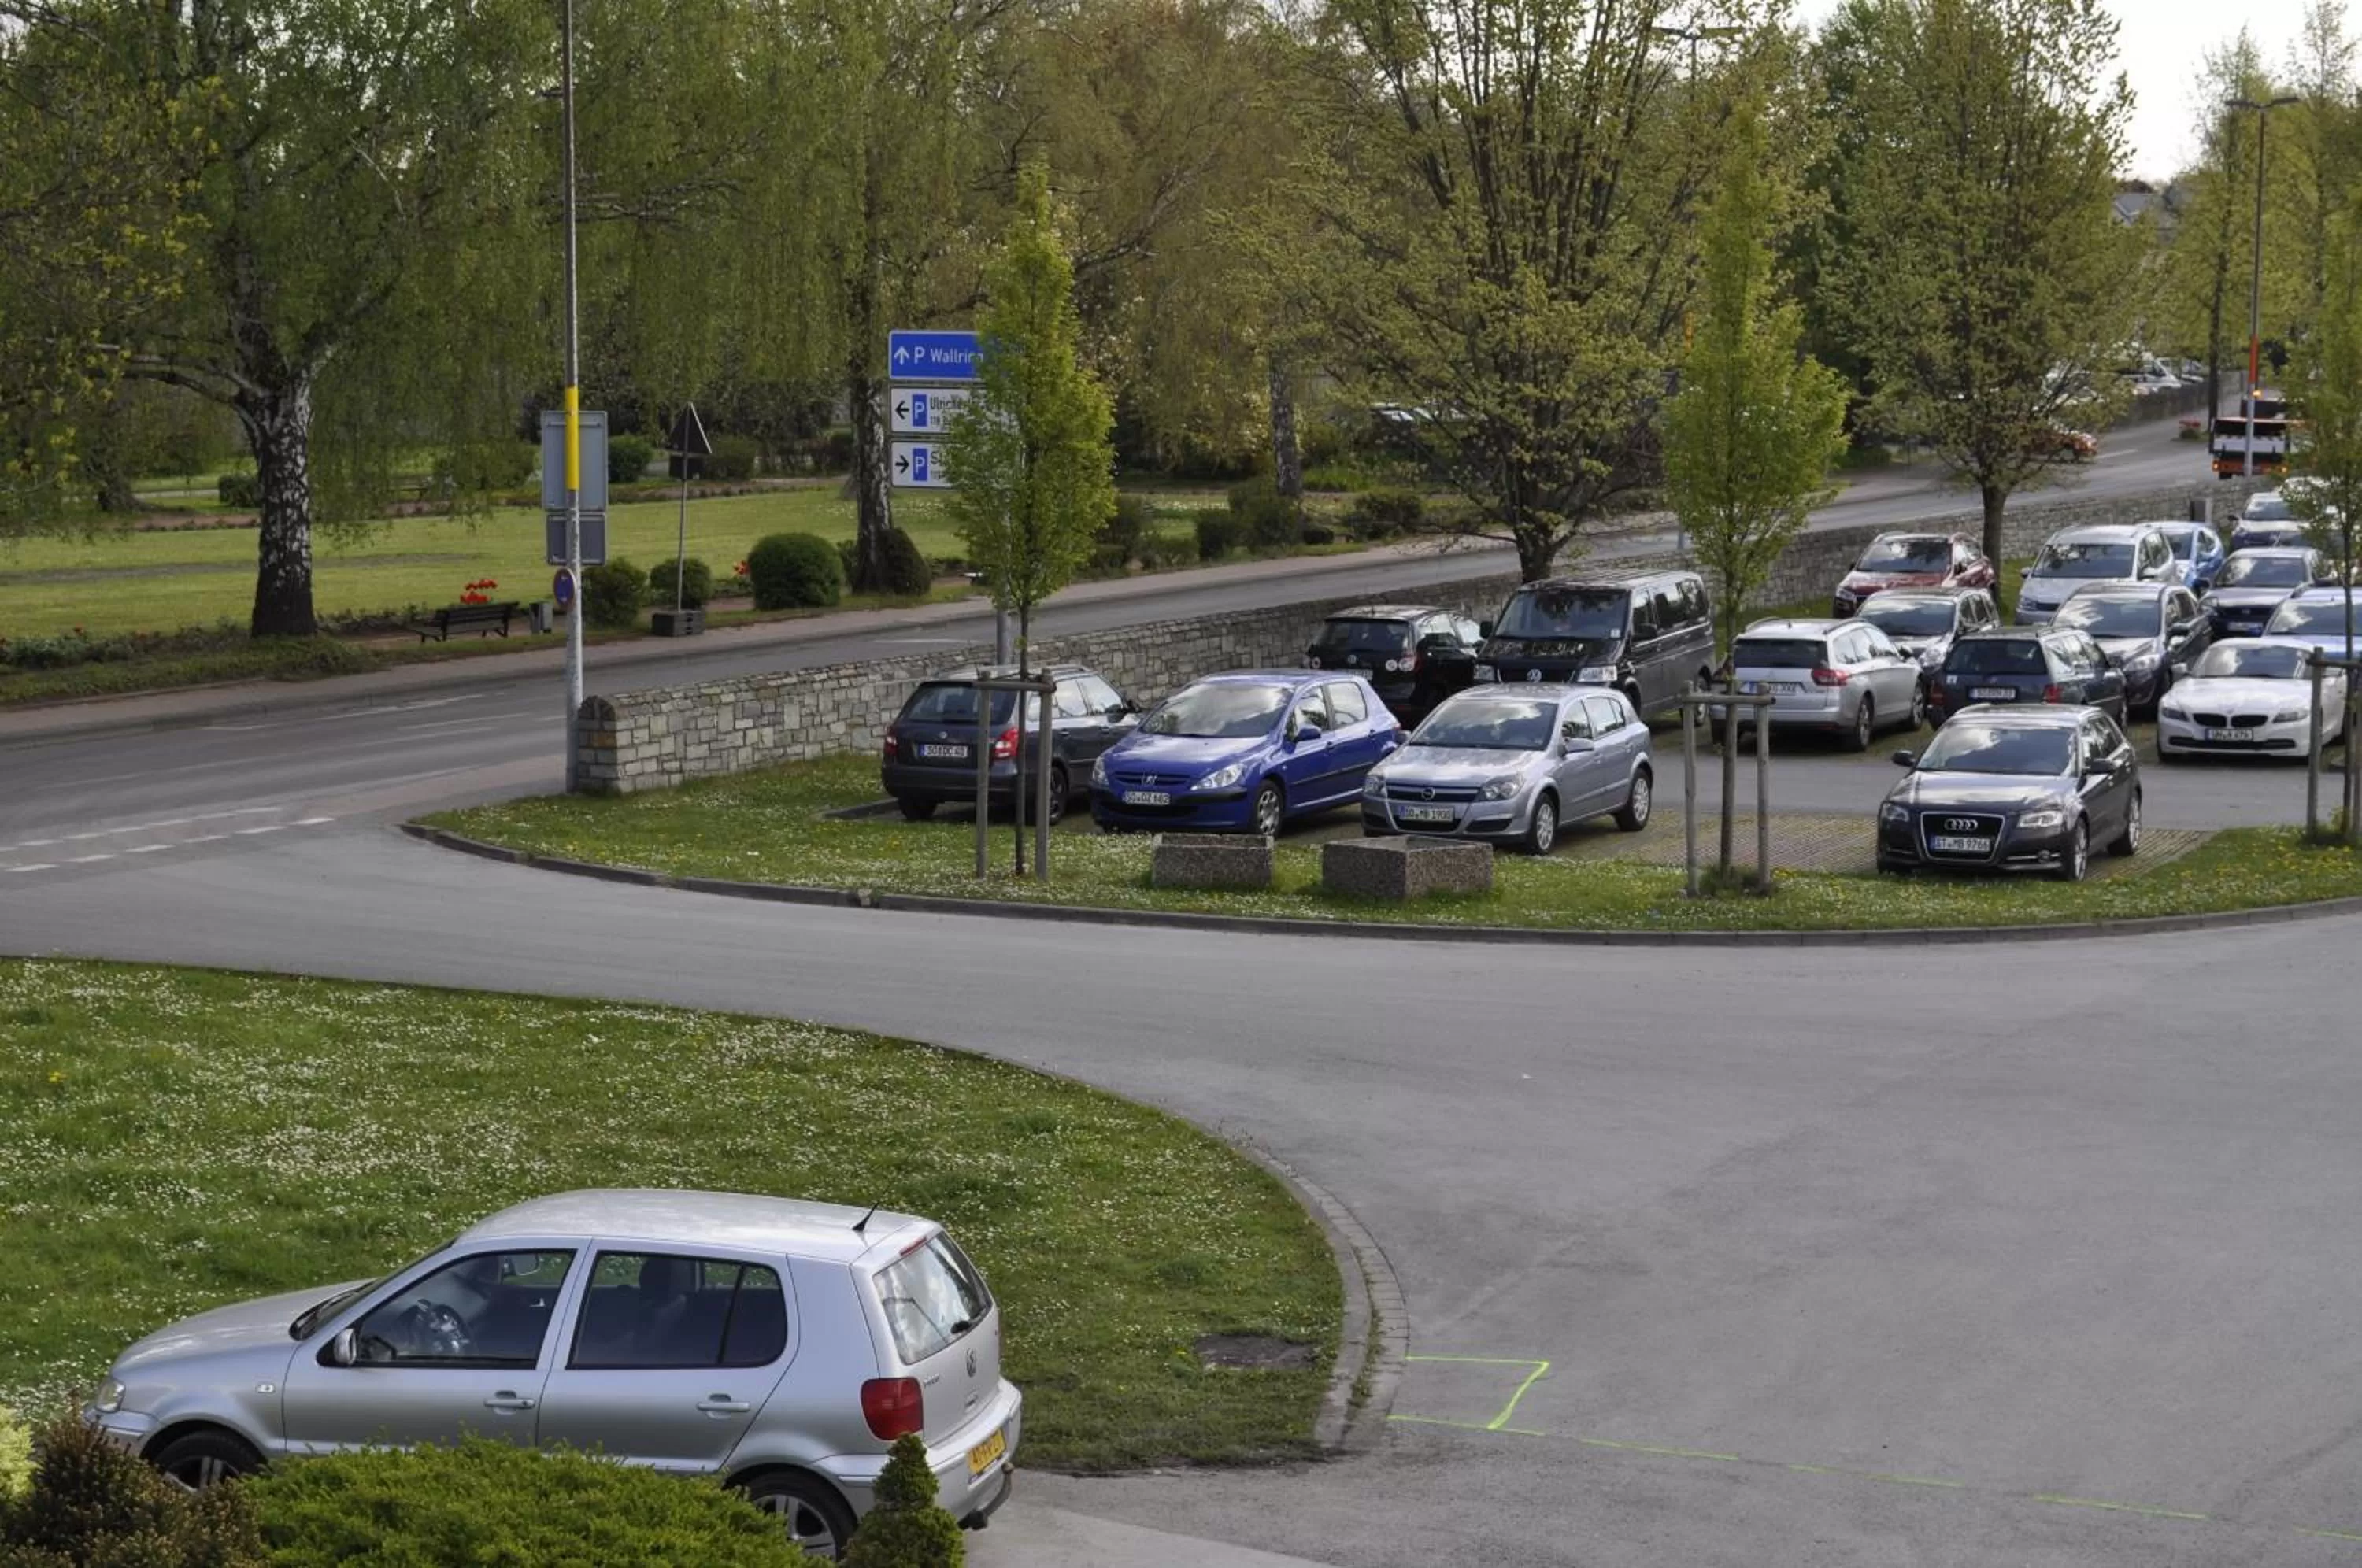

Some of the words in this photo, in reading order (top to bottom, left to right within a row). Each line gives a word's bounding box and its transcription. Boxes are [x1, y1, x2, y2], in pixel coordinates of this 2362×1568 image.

[914, 346, 925, 364] P
[914, 401, 925, 420] P
[915, 457, 926, 475] P
